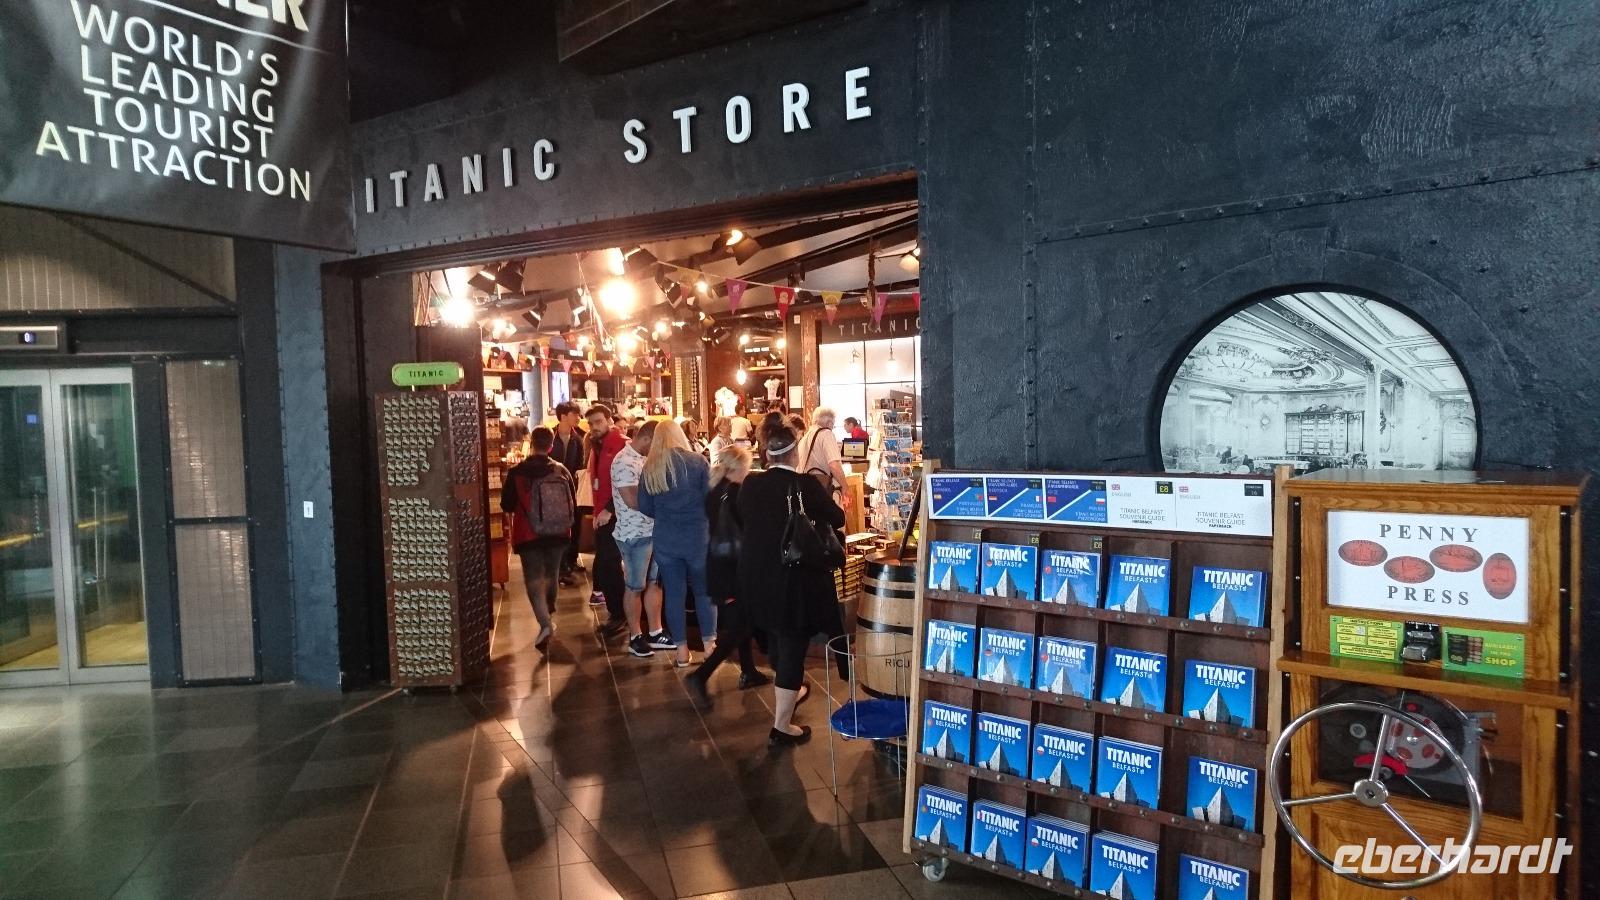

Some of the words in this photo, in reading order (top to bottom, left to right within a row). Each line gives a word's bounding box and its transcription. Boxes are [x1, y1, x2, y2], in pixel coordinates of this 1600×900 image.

[69, 0, 278, 86] WORLD'S
[81, 45, 274, 122] LEADING
[84, 87, 273, 158] TOURIST
[365, 138, 556, 213] ITANIC
[623, 66, 872, 164] STORE
[35, 120, 311, 201] ATTRACTION
[408, 369, 444, 378] TITANIC
[1159, 485, 1169, 493] £8
[1141, 508, 1164, 516] BELFAST
[1379, 523, 1479, 543] PENNY
[936, 546, 972, 560] TITANIC
[989, 546, 1028, 562] TITANIC
[1050, 553, 1090, 569] TITANIC
[1119, 562, 1166, 578] TITANIC
[1203, 570, 1254, 586] TITANIC
[1387, 585, 1469, 605] PRESS
[932, 626, 968, 643] TITANIC
[987, 633, 1027, 650] TITANIC
[1046, 641, 1086, 660] TITANIC
[1115, 654, 1161, 673] TITANIC
[1485, 656, 1517, 667] SHOP
[1195, 664, 1246, 684] TITANIC
[931, 706, 968, 726] TITANIC
[983, 720, 1022, 740] TITANIC
[1043, 735, 1086, 755] TITANIC
[1106, 747, 1152, 769] TITANIC
[1199, 761, 1249, 784] TITANIC
[926, 794, 963, 815] TITANIC
[981, 810, 1020, 832] TITANIC
[1036, 826, 1079, 849] TITANIC
[1102, 845, 1149, 868] TITANIC
[1190, 861, 1241, 886] TITANIC
